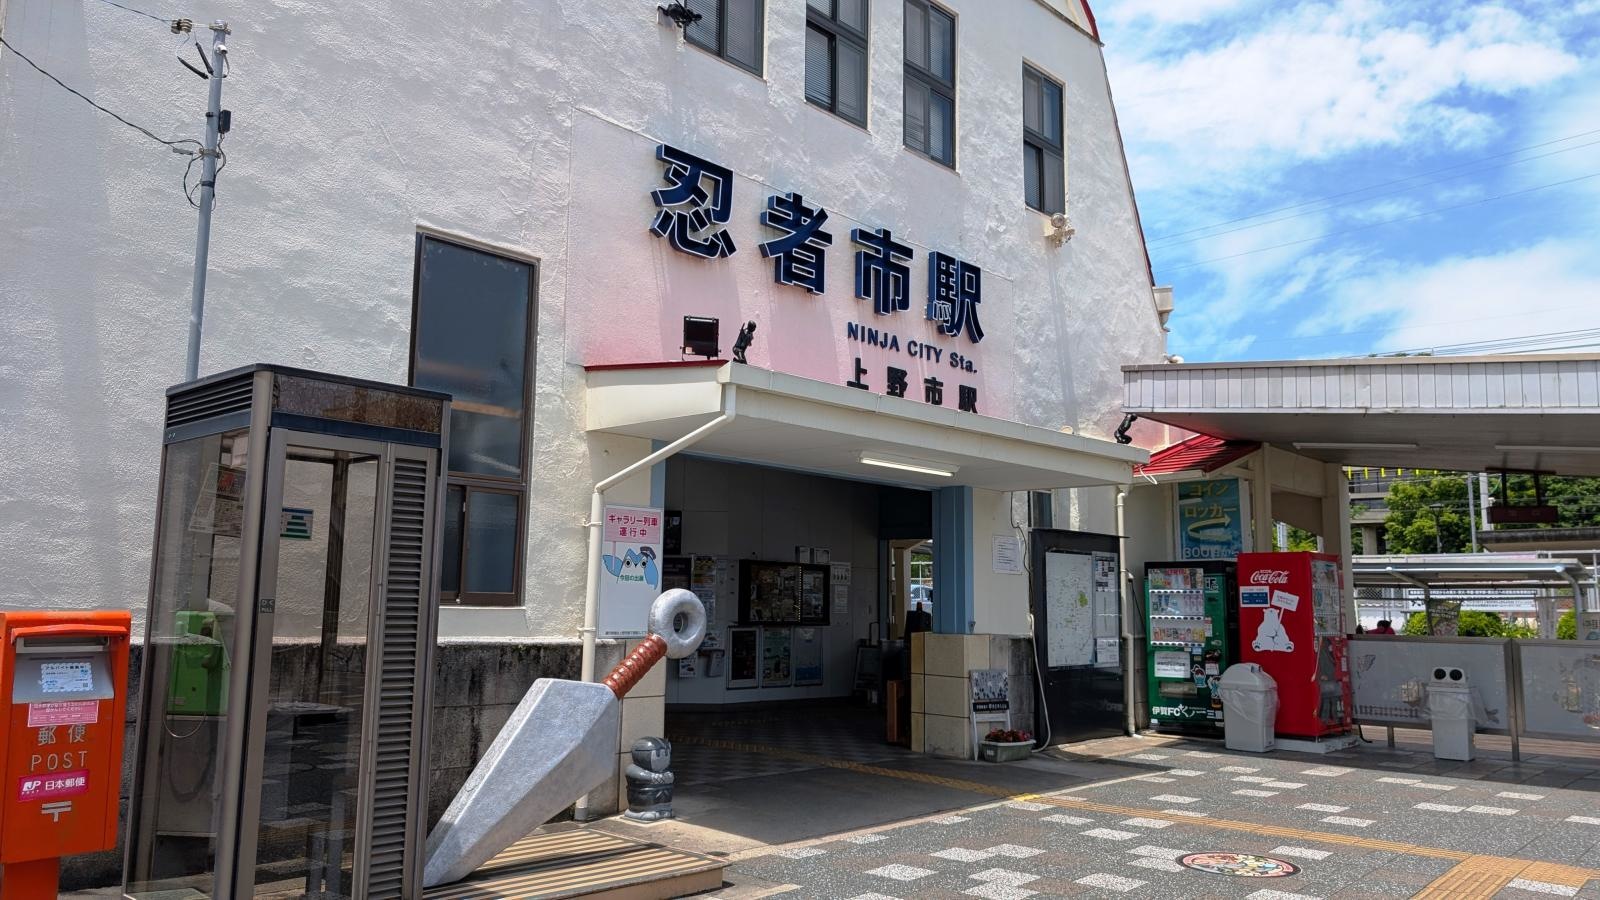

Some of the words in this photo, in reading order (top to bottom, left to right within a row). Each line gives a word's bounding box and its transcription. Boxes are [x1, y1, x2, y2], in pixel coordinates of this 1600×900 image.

[650, 143, 984, 344] 忍者市駅
[847, 321, 900, 352] NINJA
[907, 340, 943, 363] CITY
[949, 351, 978, 374] Sta.
[847, 357, 978, 414] 上野市駅
[1189, 482, 1229, 496] コイン
[1184, 503, 1237, 518] ロッカー
[608, 514, 658, 526] ギャラリー列車
[619, 527, 647, 537] 運行中
[38, 724, 86, 746] 郵便
[30, 751, 88, 771] POST
[45, 777, 86, 791] 日本郵便
